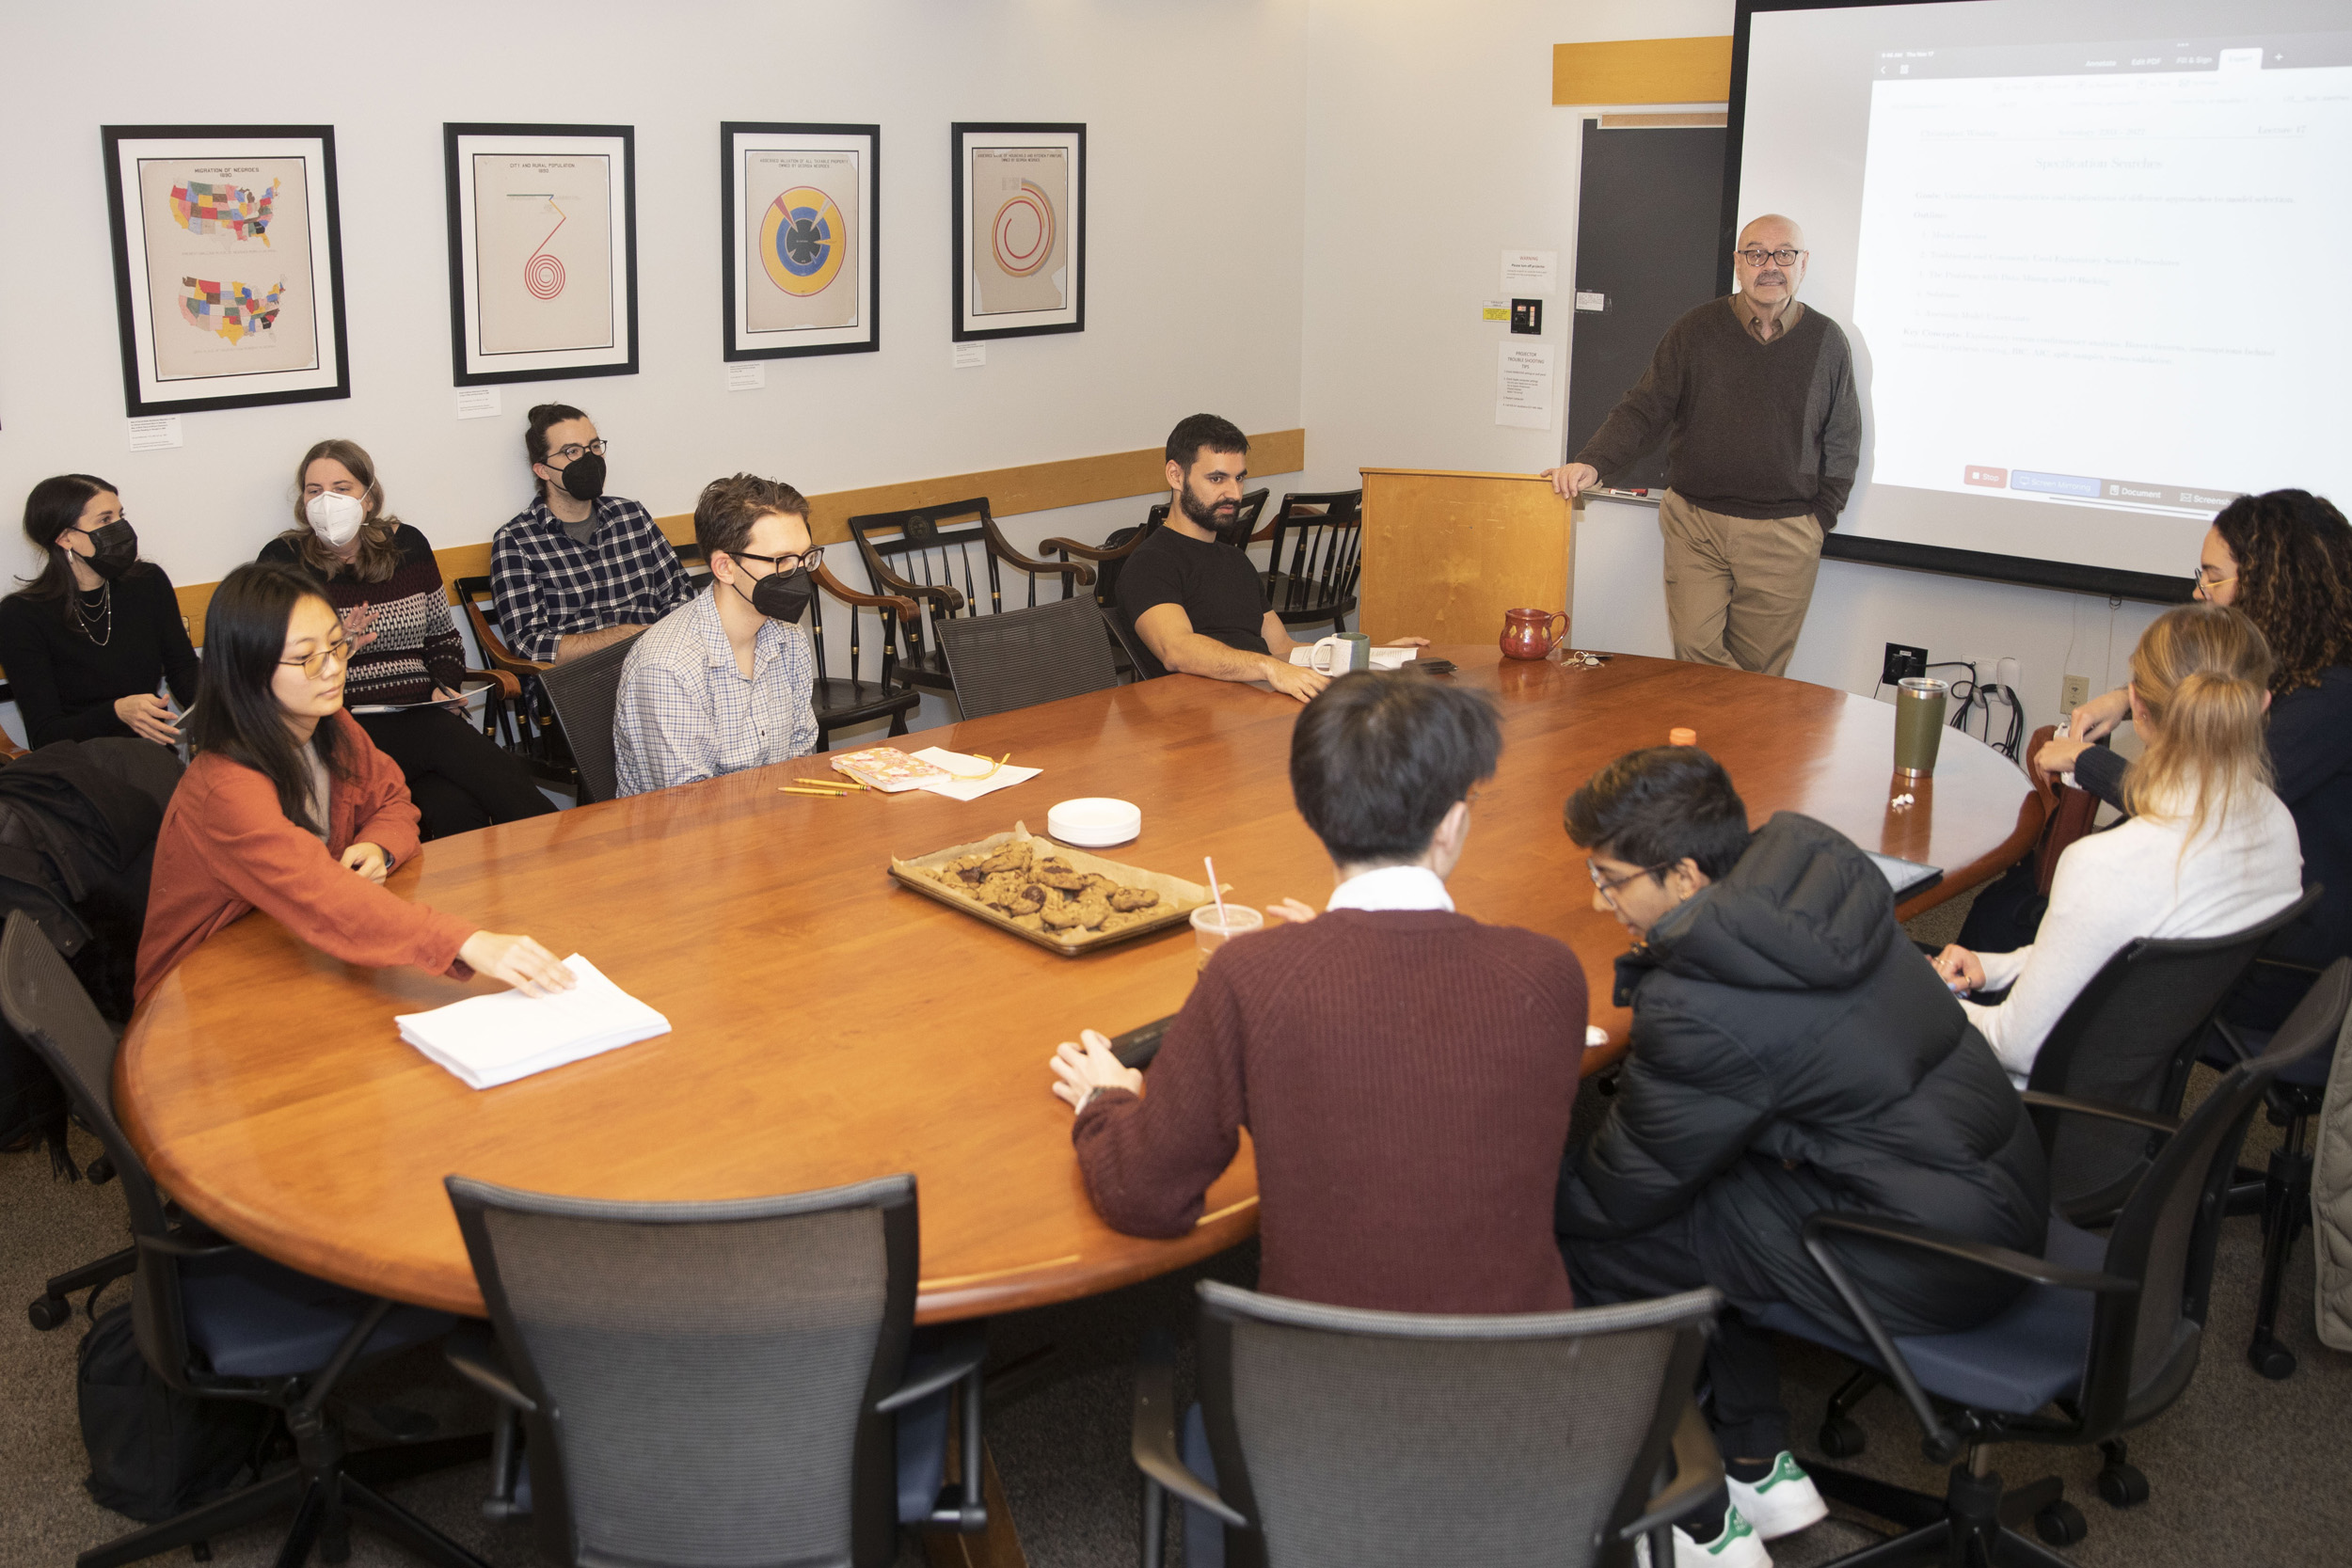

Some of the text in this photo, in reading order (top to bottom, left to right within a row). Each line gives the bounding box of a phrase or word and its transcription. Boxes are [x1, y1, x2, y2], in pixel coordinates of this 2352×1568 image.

[2196, 56, 2212, 65] Sign
[2034, 157, 2163, 171] Specification Searches
[1982, 473, 2000, 482] Stop
[2032, 478, 2091, 492] Screen Mirroring
[2122, 487, 2162, 499] Document
[2193, 495, 2233, 506] Screensh
